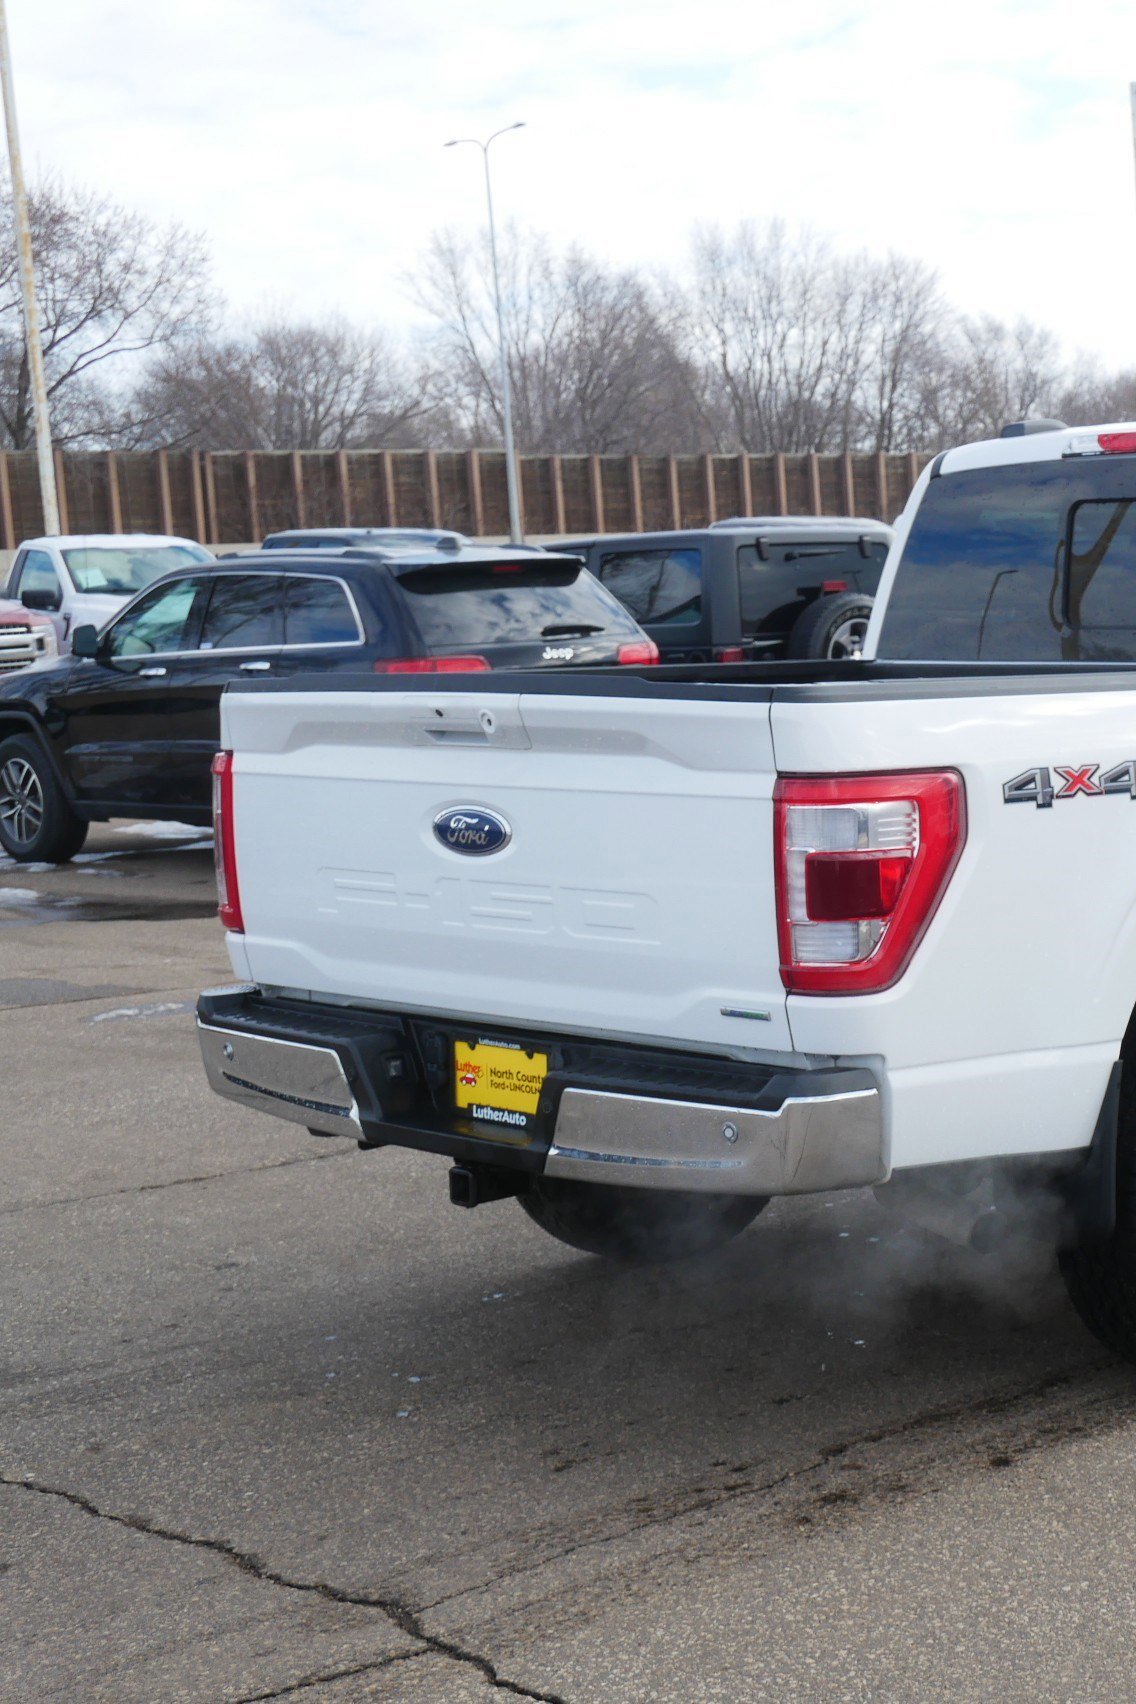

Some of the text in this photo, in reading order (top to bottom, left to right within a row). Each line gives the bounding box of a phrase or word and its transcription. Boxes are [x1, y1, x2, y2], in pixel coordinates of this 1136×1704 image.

[542, 646, 574, 660] Jeep
[446, 815, 490, 845] Ford
[314, 865, 664, 948] F-150
[489, 1067, 514, 1080] North
[472, 1104, 527, 1126] LutherAuto
